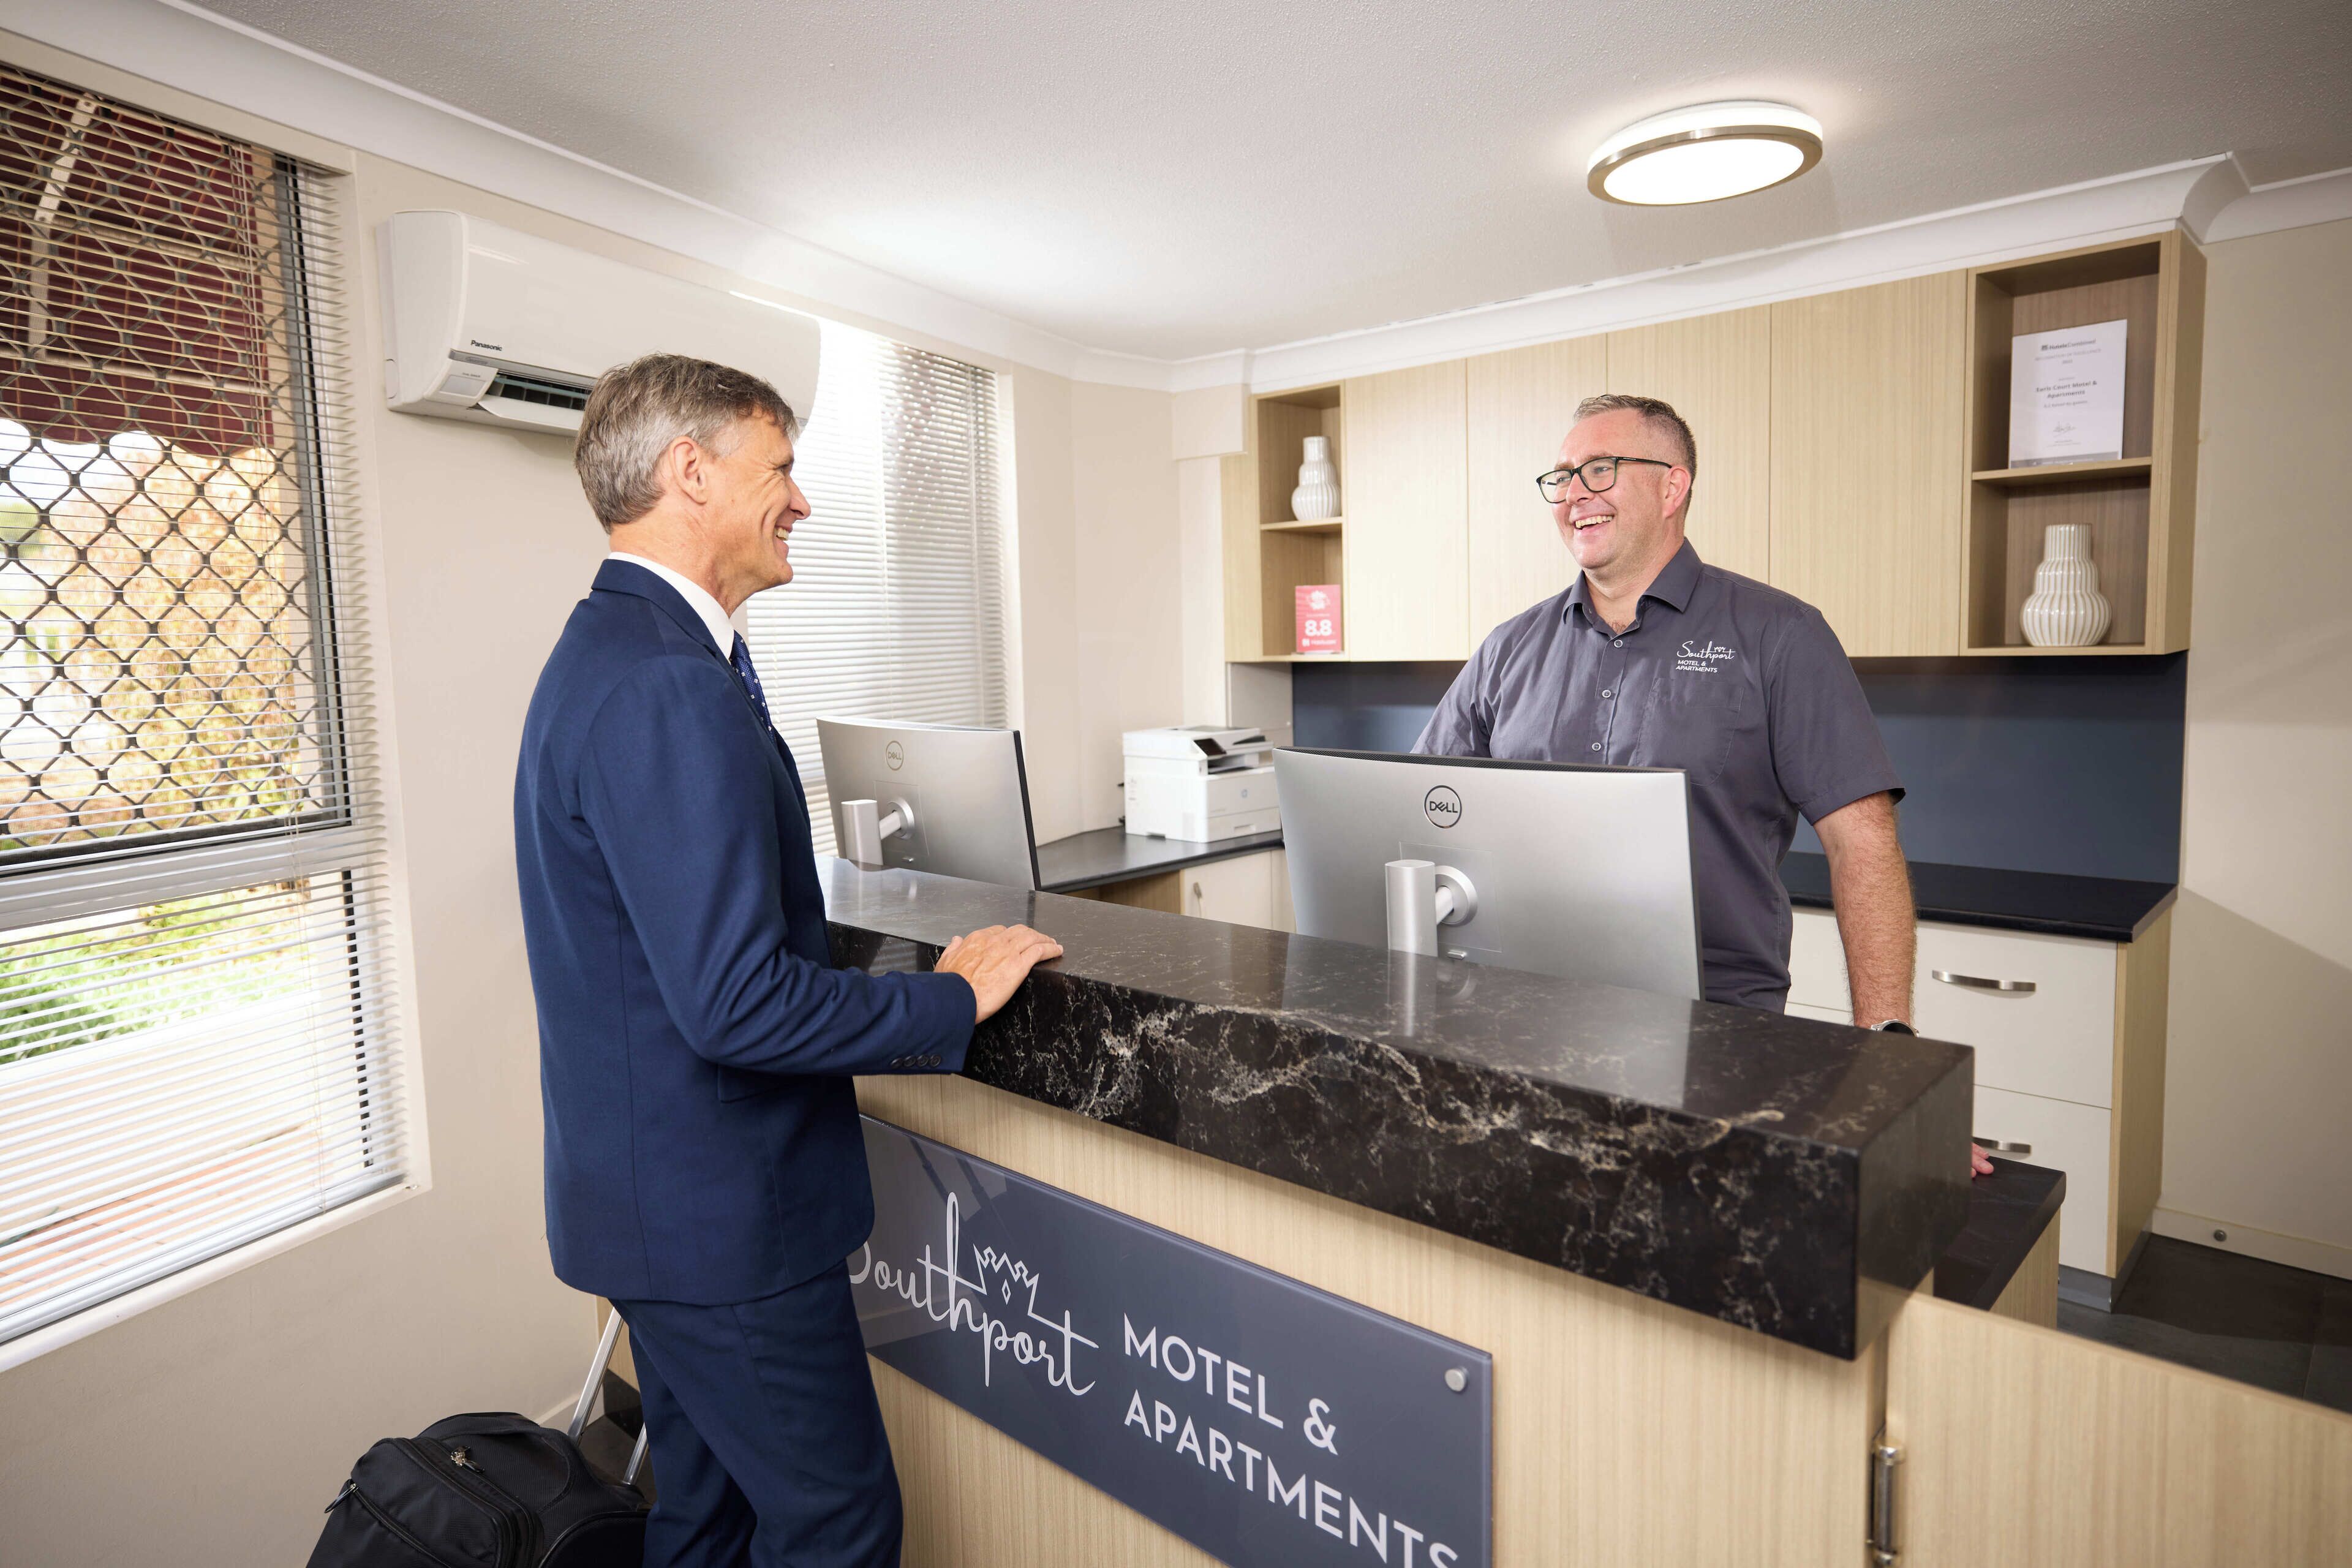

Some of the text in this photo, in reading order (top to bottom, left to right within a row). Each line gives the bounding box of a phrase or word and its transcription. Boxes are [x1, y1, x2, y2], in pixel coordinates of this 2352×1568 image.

[470, 340, 502, 351] Panasonic
[1305, 619, 1332, 637] 8.8
[1676, 640, 1735, 663] Southport
[888, 752, 902, 760] DELL
[1429, 801, 1458, 813] DELL
[1124, 1313, 1338, 1455] MOTEL &
